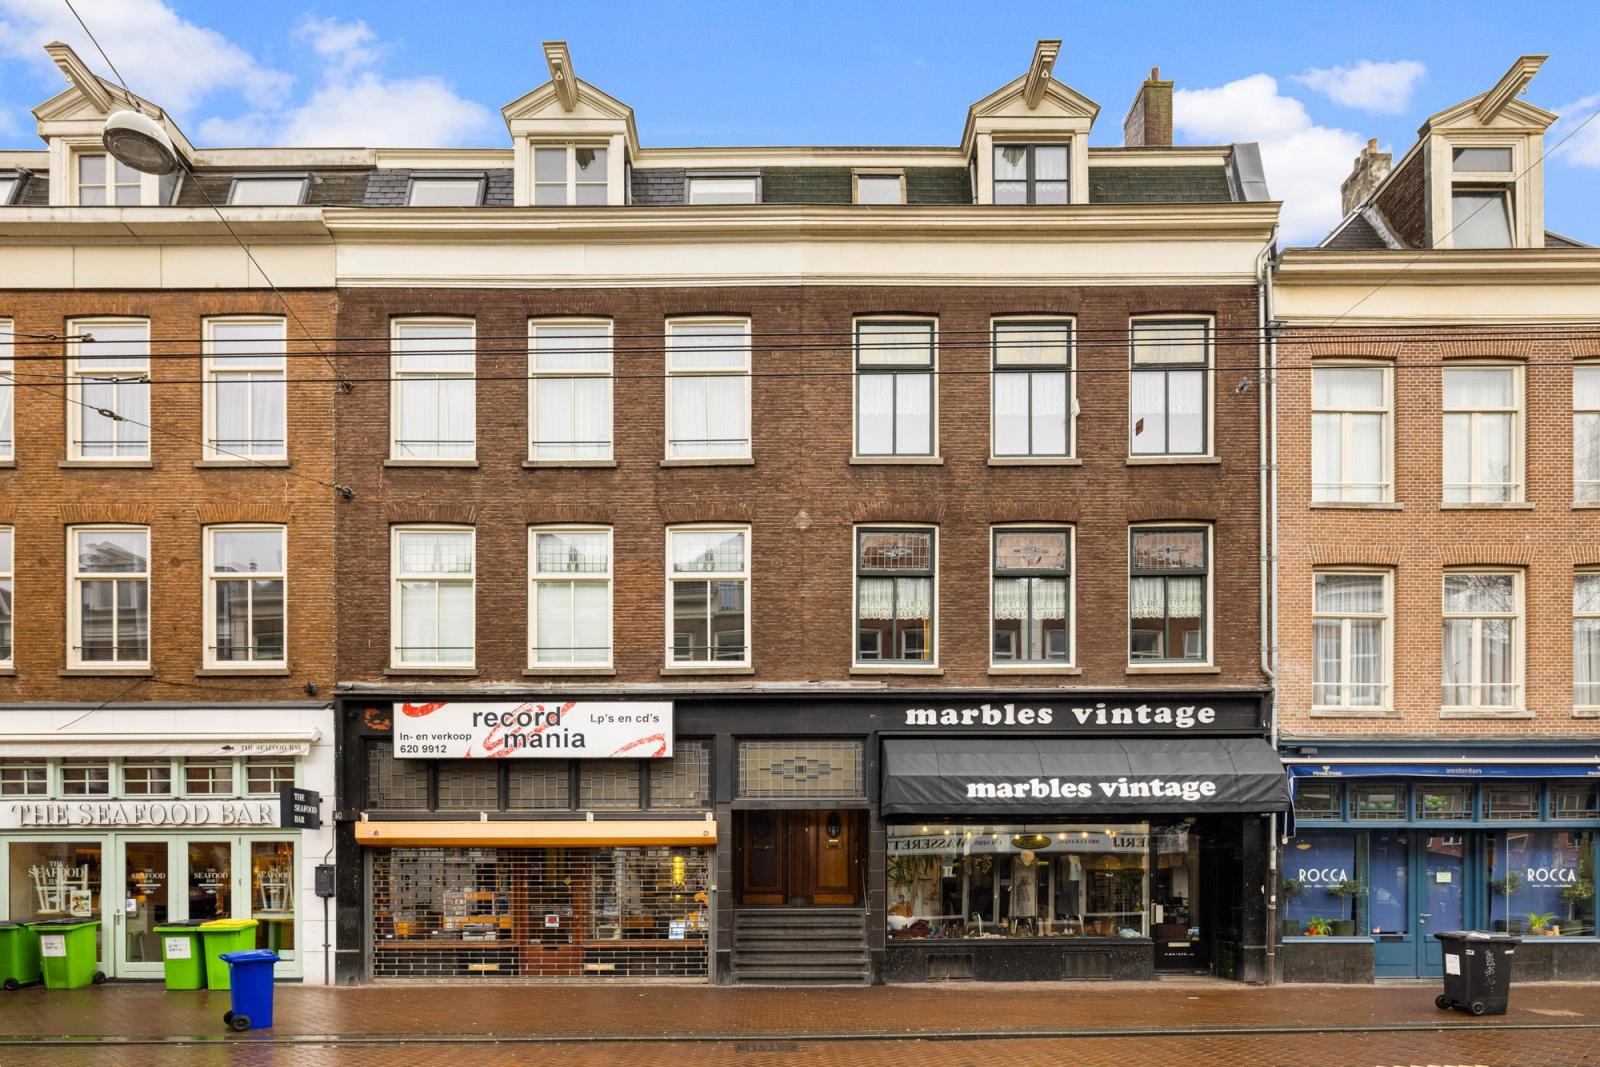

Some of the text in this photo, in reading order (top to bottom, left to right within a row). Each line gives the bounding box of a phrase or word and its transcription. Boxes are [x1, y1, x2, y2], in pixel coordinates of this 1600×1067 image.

[472, 706, 561, 727] record
[590, 713, 660, 725] Lp's en cd's
[905, 703, 1216, 728] marbles vintage
[415, 733, 429, 741] en
[431, 732, 472, 742] verkoop
[503, 728, 586, 748] mania
[400, 744, 447, 753] 620 9912
[1446, 767, 1482, 775] amsterdam
[966, 778, 1217, 801] marbles vintage
[293, 792, 305, 802] THE
[12, 803, 274, 826] THE SEAFOOD BAR
[293, 804, 318, 815] SEAFOOD
[294, 815, 305, 824] BAR
[28, 867, 85, 878] SEAFOOD
[1298, 868, 1348, 882] ROCCA
[1527, 868, 1577, 882] ROCCA
